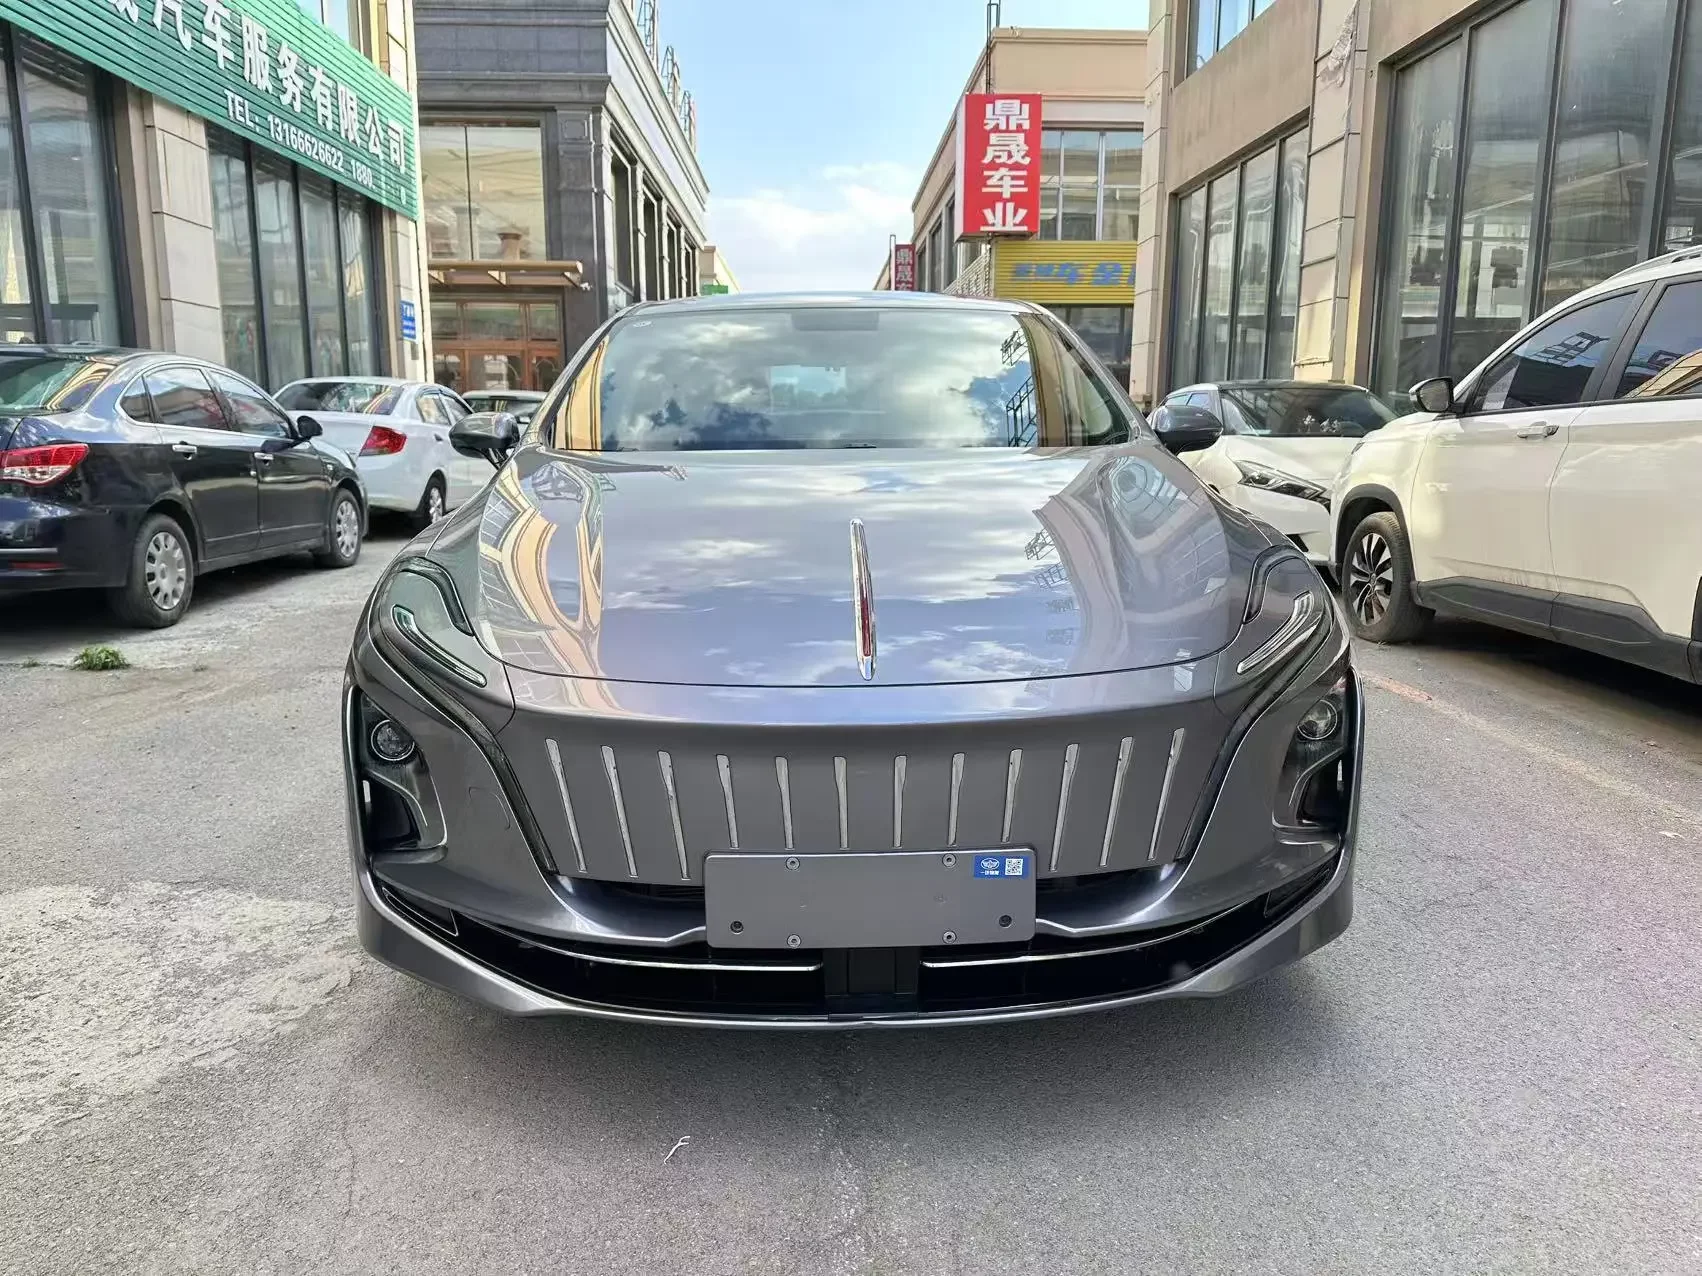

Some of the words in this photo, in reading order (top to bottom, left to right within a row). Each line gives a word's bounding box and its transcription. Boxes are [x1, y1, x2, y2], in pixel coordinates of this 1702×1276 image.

[109, 0, 406, 174] 汽车服务有限公司
[267, 114, 345, 172] 13166626622
[980, 99, 1031, 231] 鼎晟车业
